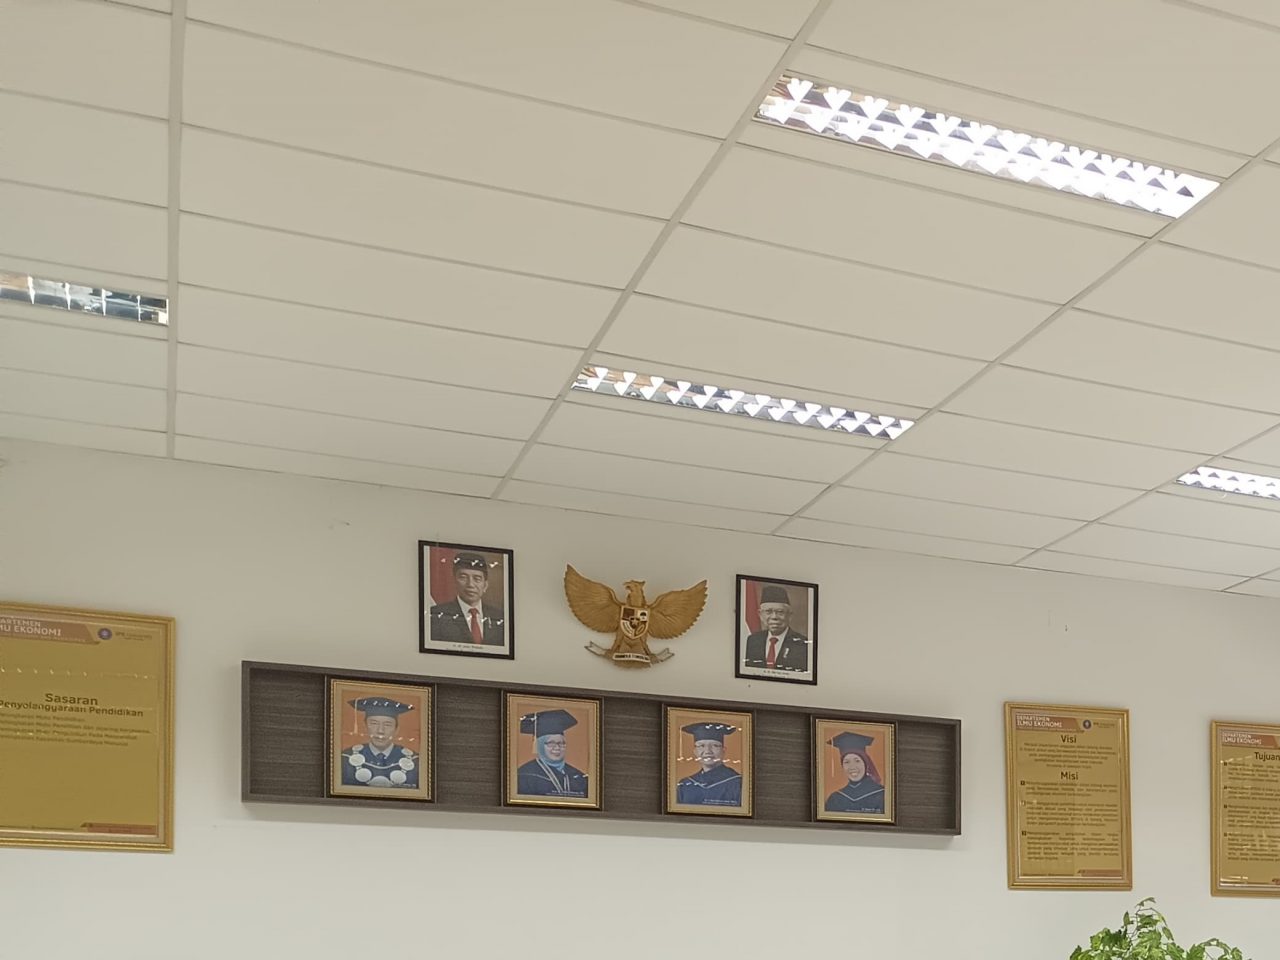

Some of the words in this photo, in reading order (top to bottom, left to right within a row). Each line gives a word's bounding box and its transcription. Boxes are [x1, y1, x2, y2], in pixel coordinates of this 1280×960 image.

[14, 625, 62, 637] EKONOMI
[45, 693, 98, 706] Sasaran
[89, 706, 144, 717] Pendidikan
[1061, 735, 1077, 743] Visi
[1254, 751, 1280, 762] Tujuan
[1060, 772, 1078, 780] Misi
